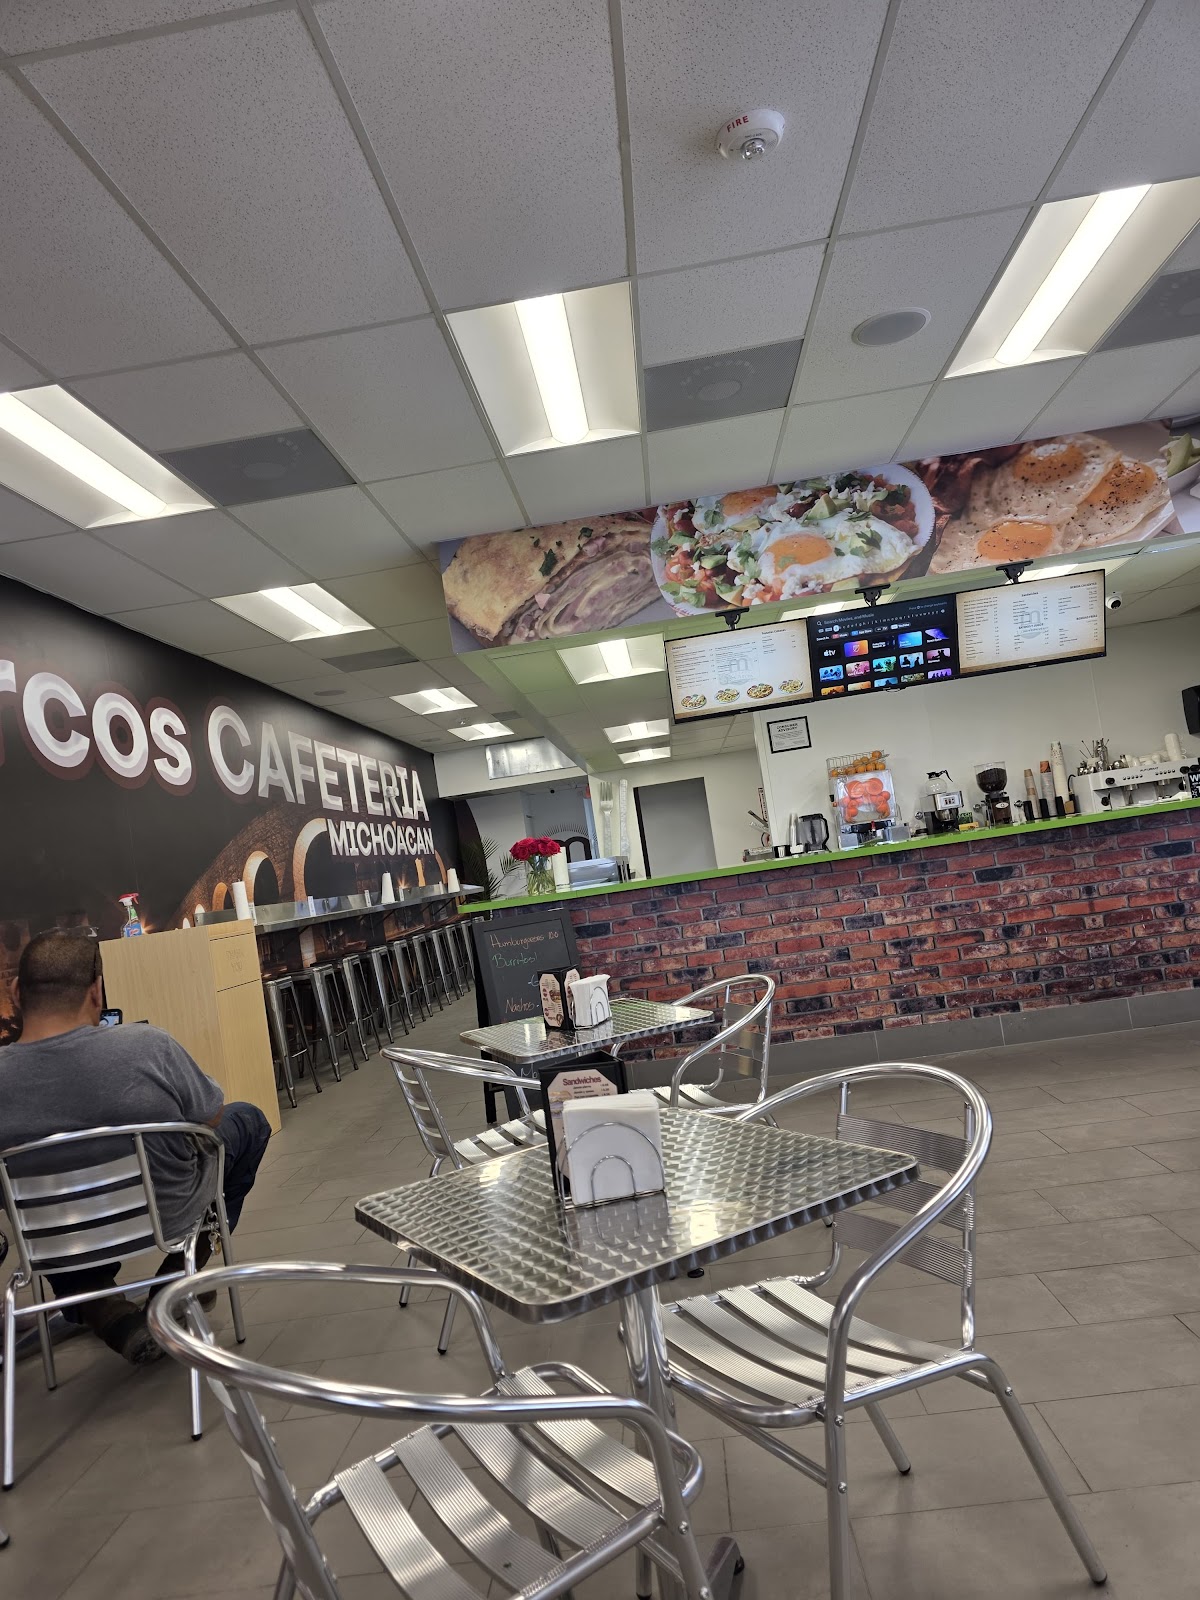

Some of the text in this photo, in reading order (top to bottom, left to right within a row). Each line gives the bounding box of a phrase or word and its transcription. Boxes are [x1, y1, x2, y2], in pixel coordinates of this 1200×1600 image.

[726, 115, 750, 133] FIRE
[0, 659, 430, 822] cos CAFETERIA
[562, 1075, 602, 1087] Sandwiches
